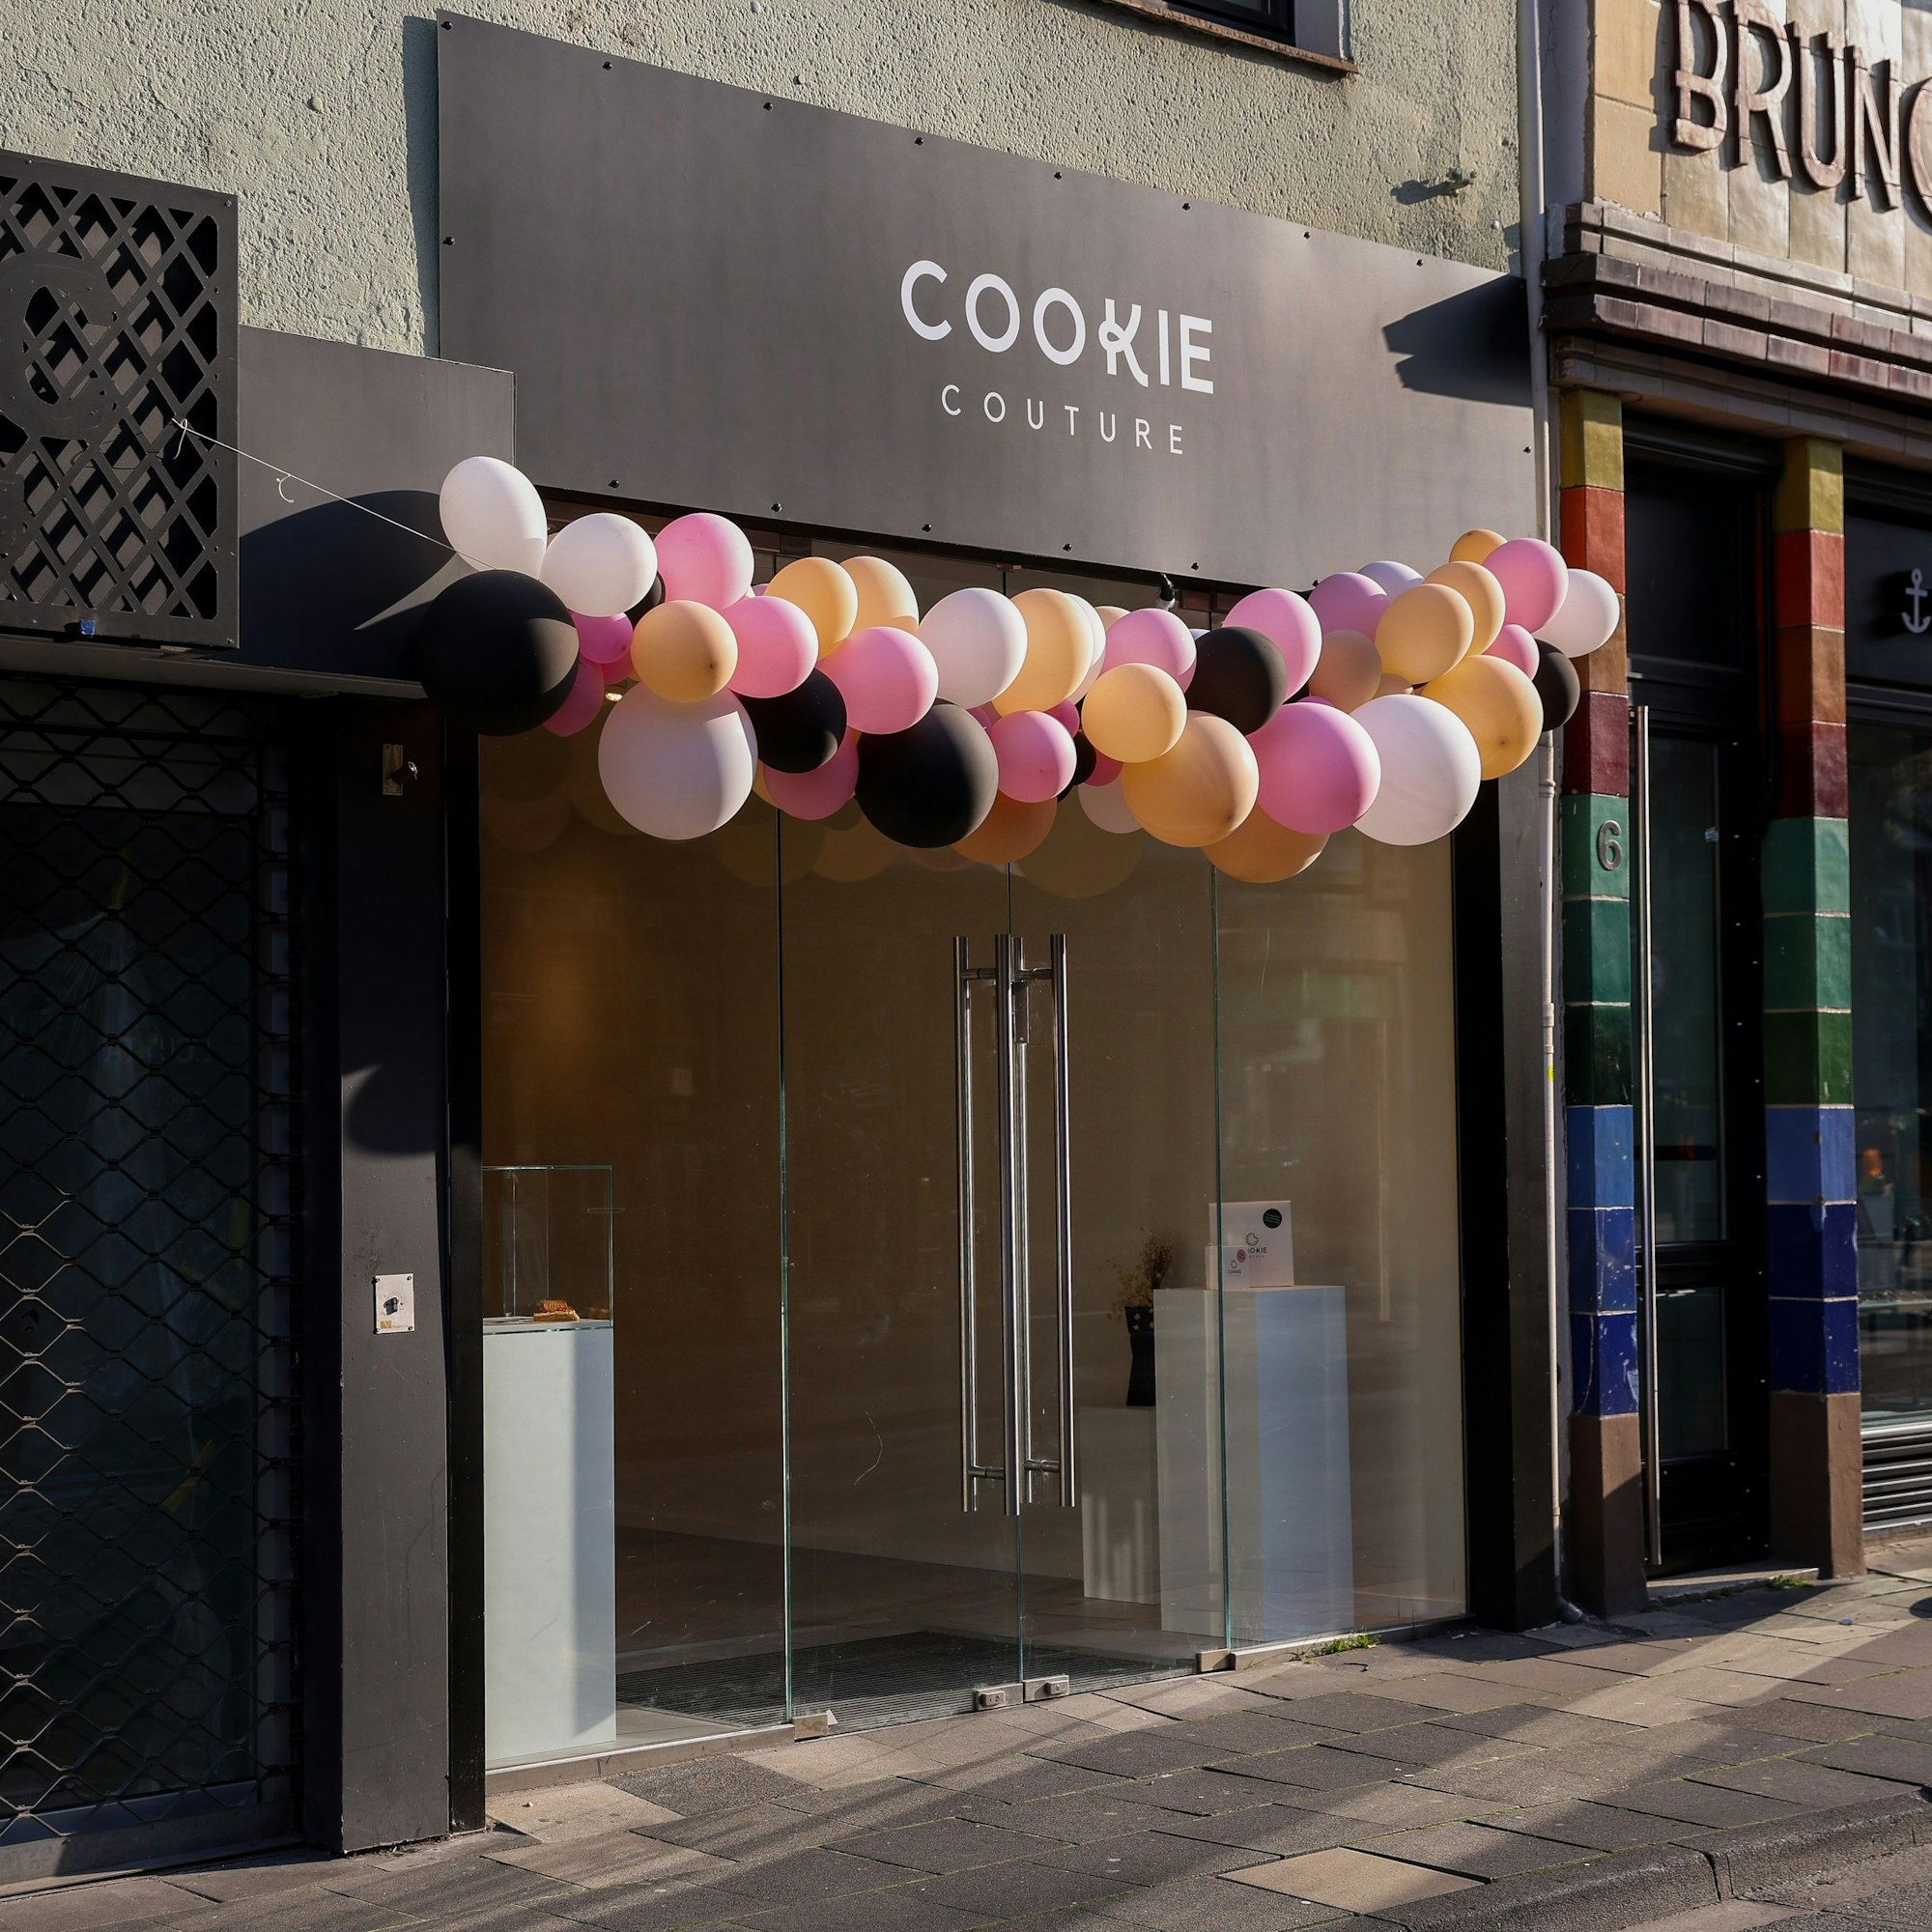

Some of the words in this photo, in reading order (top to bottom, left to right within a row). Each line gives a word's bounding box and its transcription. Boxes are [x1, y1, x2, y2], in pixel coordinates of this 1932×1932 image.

[901, 260, 1213, 394] COOKIE
[942, 384, 1182, 454] COUTURE
[1597, 819, 1623, 871] 6
